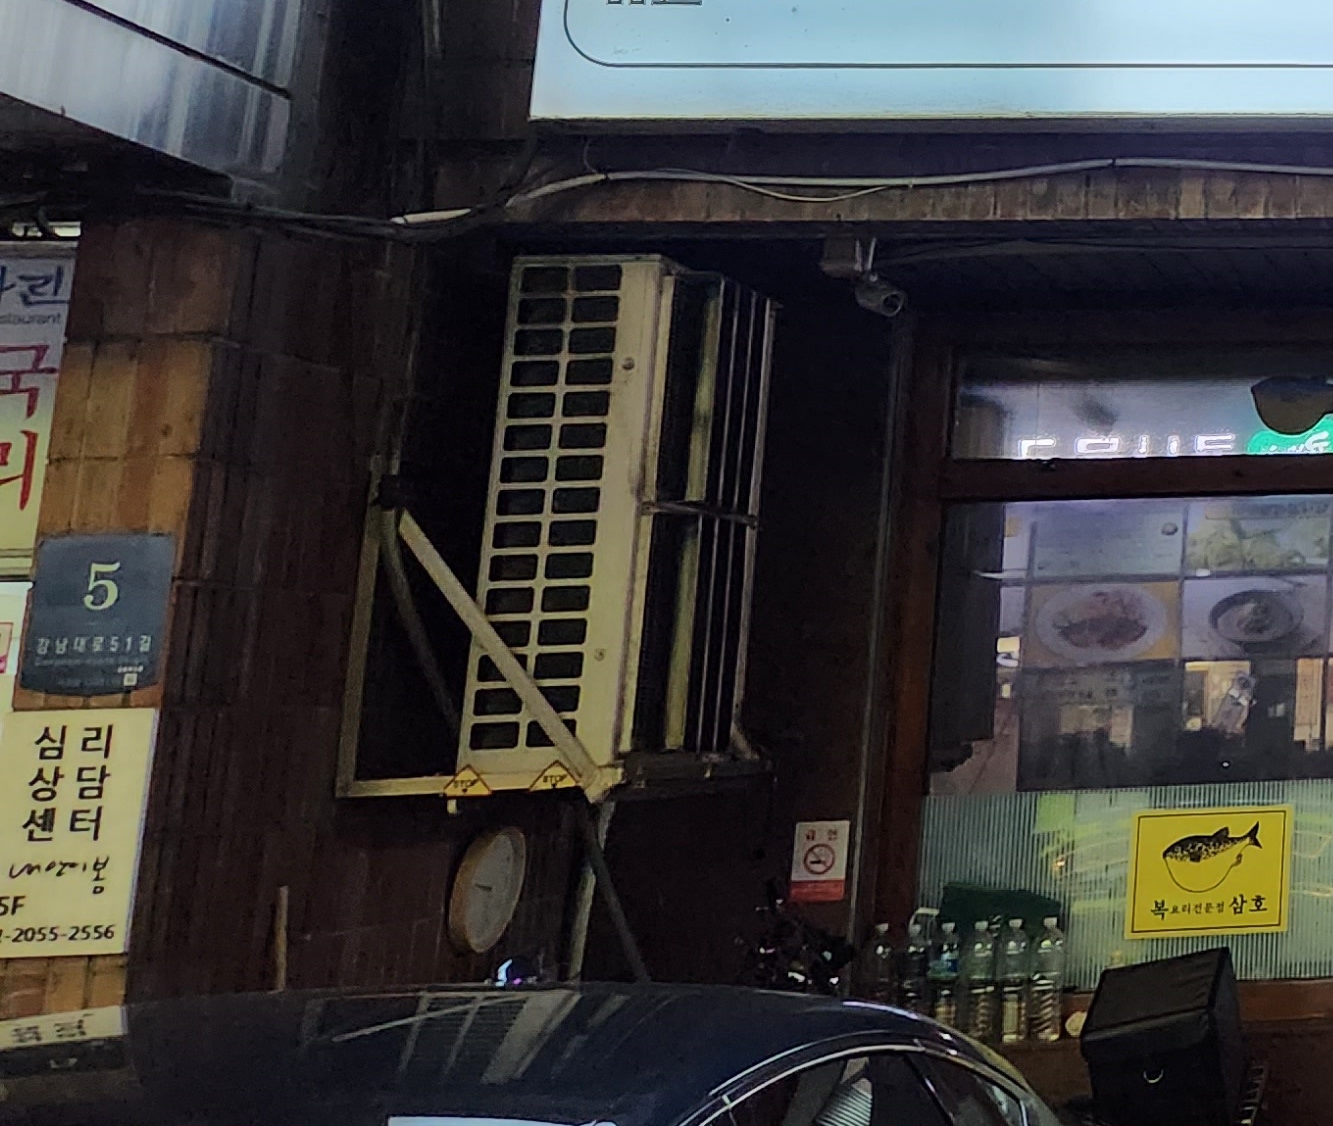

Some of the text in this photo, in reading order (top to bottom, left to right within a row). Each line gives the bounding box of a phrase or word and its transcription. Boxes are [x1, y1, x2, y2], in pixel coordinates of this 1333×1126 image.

[0, 265, 70, 306] 린
[83, 560, 121, 610] 5
[34, 724, 115, 761] 심리
[28, 764, 111, 802] 상담
[22, 805, 104, 842] 센터
[1150, 899, 1168, 921] 복
[1229, 893, 1268, 916] 삼호
[0, 924, 116, 943] -2055-2556
